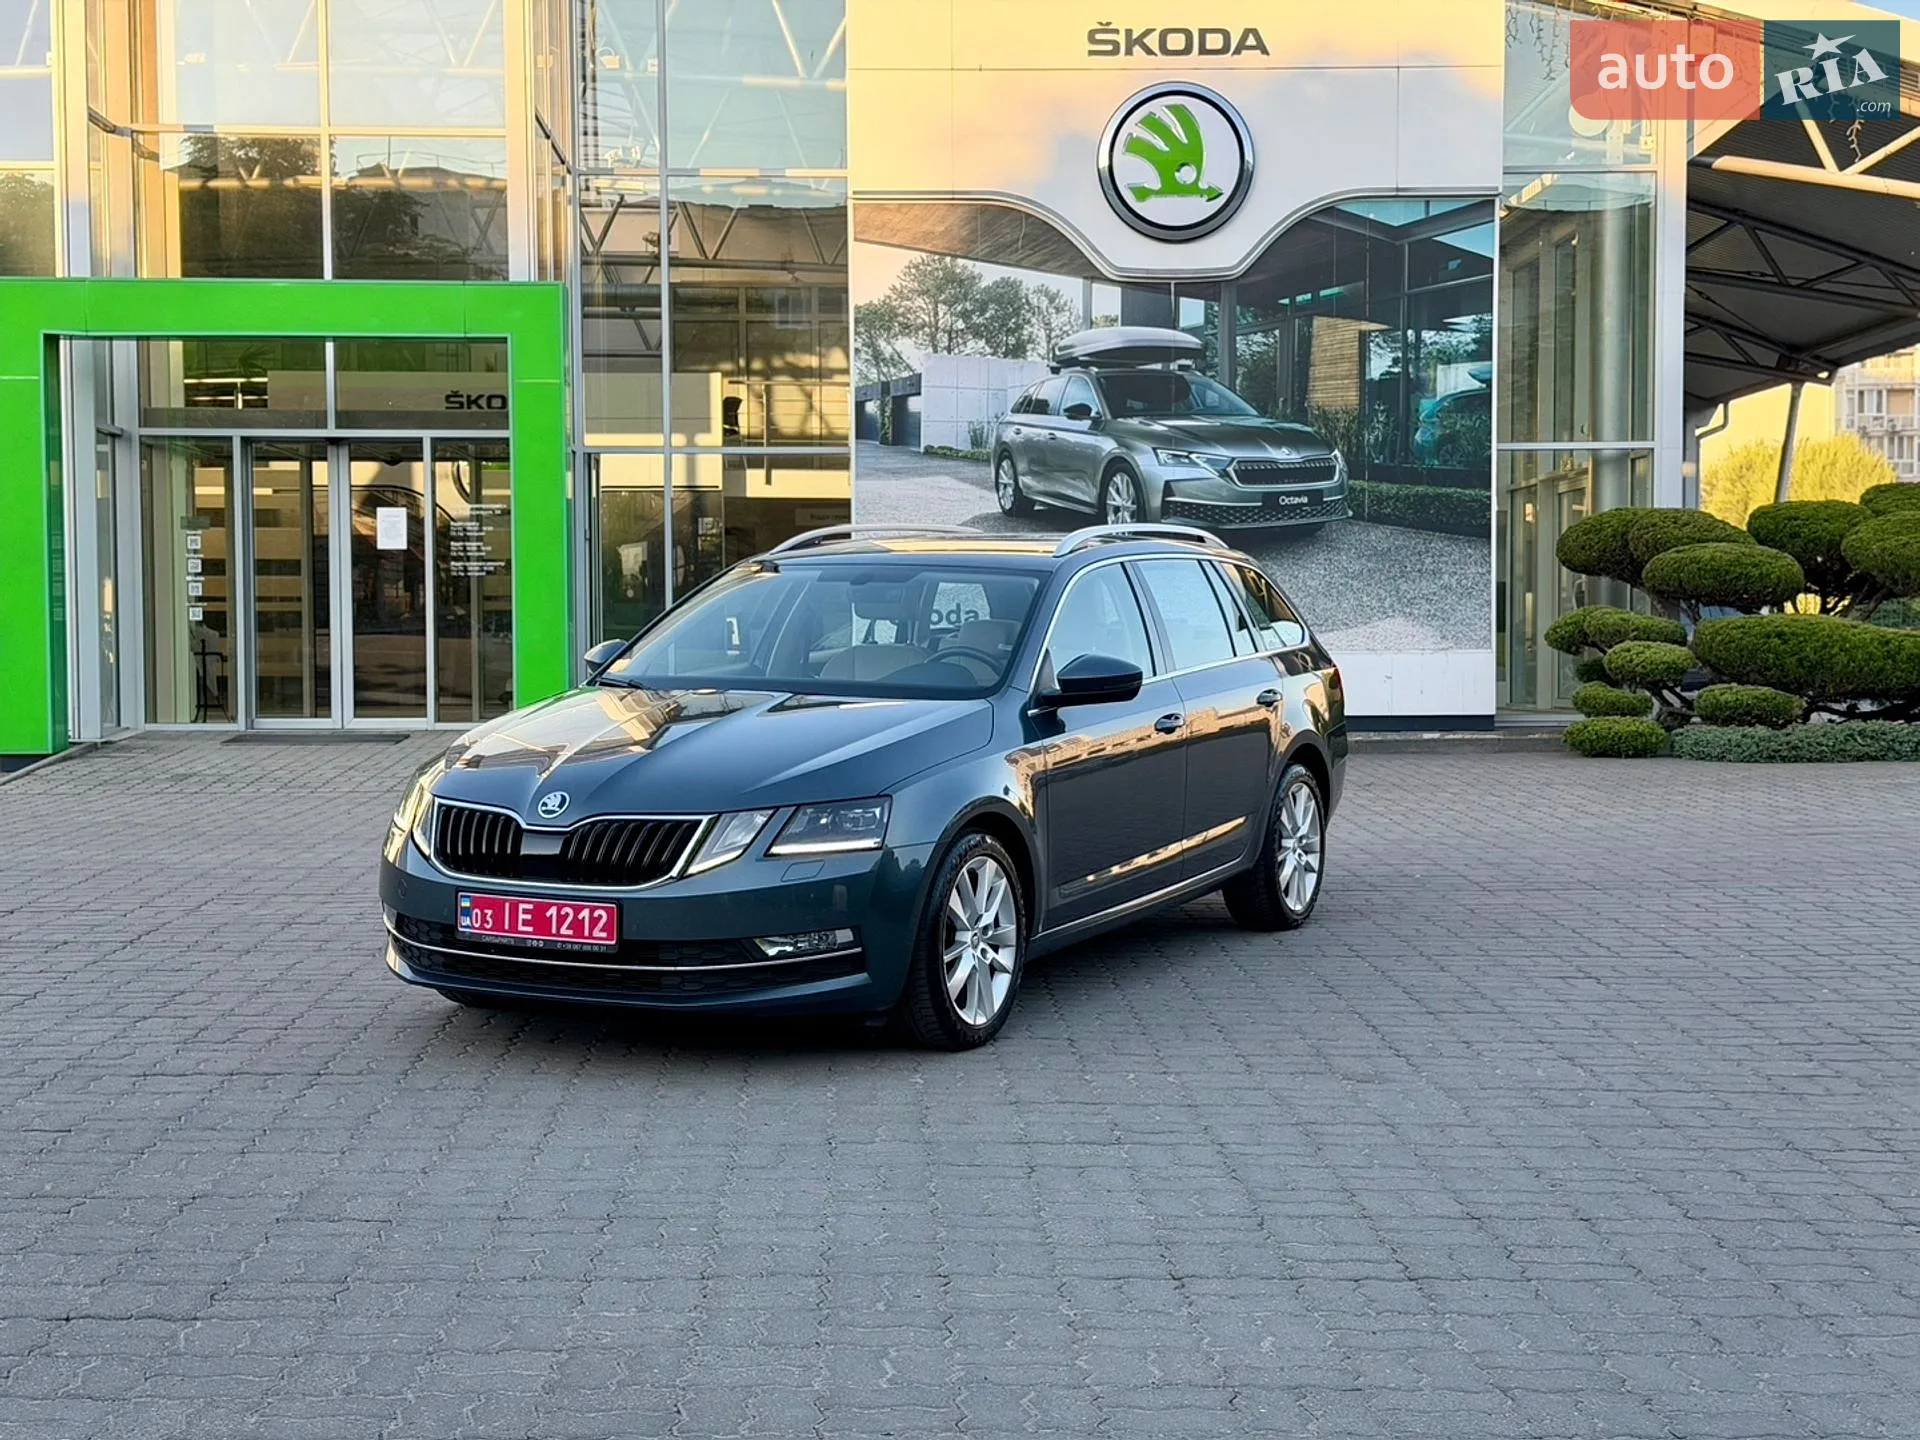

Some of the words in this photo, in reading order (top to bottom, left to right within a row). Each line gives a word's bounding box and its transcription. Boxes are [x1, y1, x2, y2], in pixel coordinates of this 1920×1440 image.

[1087, 21, 1270, 57] ŠKODA
[444, 390, 508, 410] ŠKO
[1278, 495, 1308, 505] Octavia
[461, 916, 472, 926] UA
[471, 908, 494, 929] 03
[503, 902, 535, 932] IE
[545, 905, 608, 938] 1212
